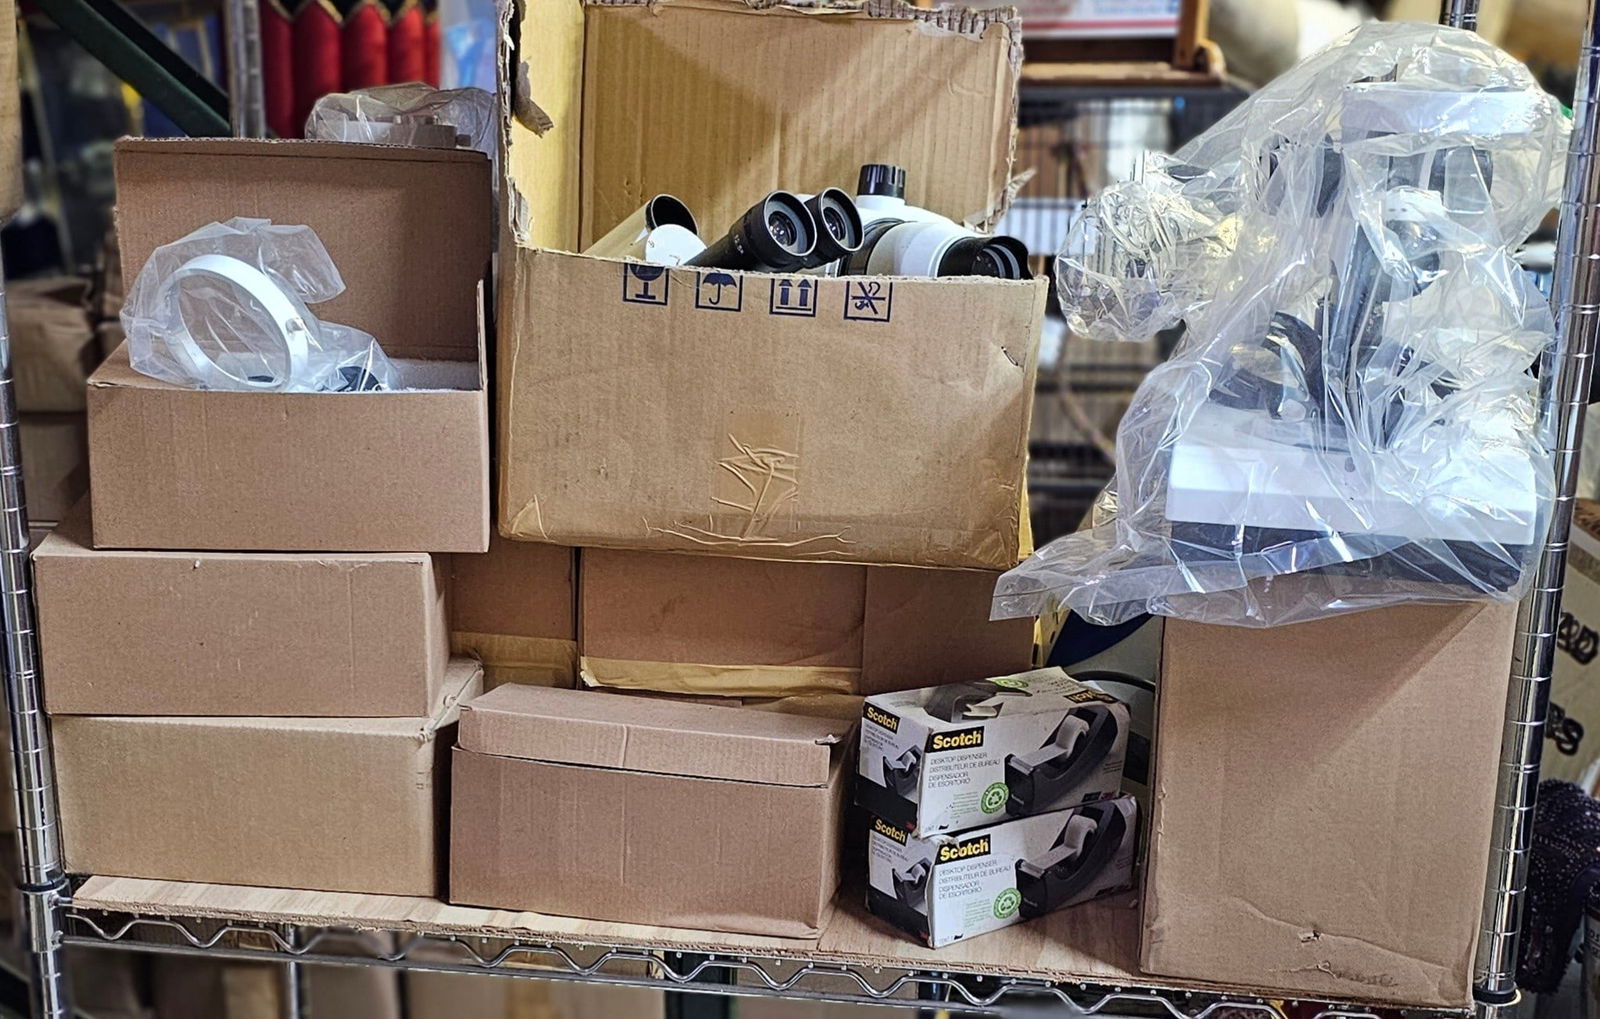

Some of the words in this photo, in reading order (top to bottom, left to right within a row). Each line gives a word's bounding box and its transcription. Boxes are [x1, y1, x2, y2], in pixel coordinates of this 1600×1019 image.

[867, 706, 897, 730] Scotch
[933, 731, 982, 749] Scotch
[929, 763, 969, 773] DISTRIBUTEUR
[978, 759, 1001, 768] BUREAU
[930, 757, 956, 765] DESKTOP
[957, 752, 988, 761] DISPENSER
[928, 771, 969, 781] DISPENSADOR
[937, 777, 971, 788] ESCRITORIO
[875, 819, 906, 842] Scotch
[939, 839, 989, 861] Scotch
[939, 867, 965, 875] DESKTOP
[967, 859, 998, 871] DISPENSER
